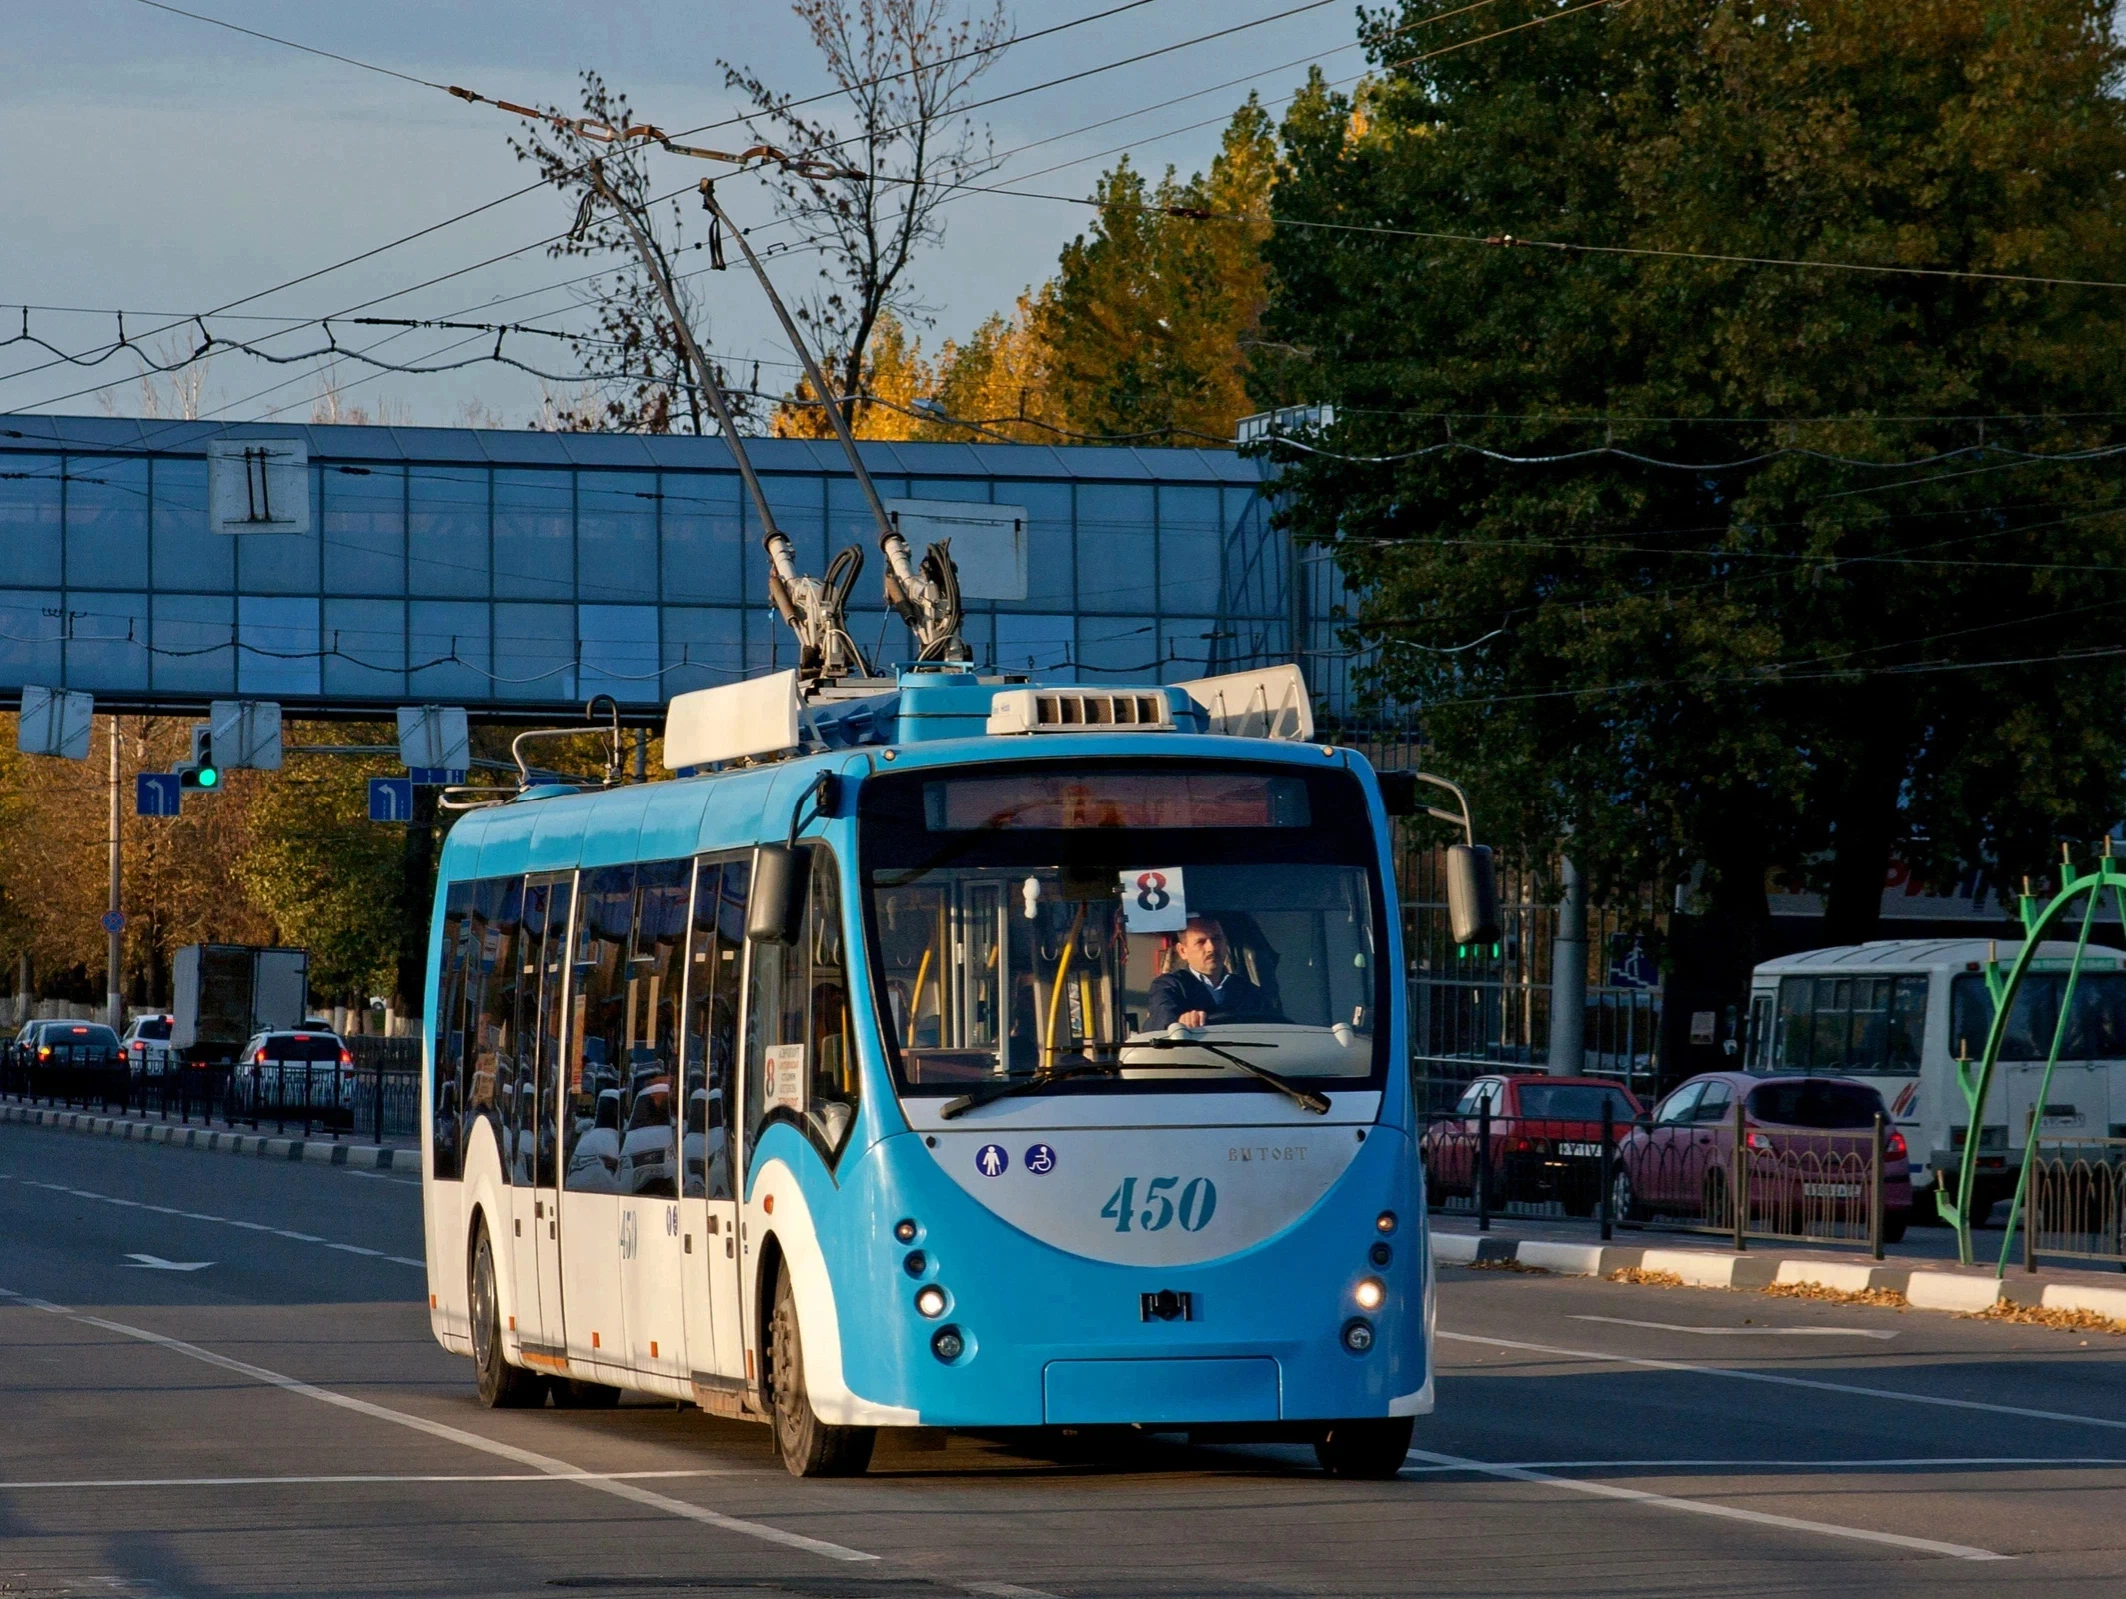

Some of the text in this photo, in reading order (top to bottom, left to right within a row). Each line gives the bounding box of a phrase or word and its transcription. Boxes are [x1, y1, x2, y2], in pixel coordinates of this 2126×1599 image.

[1137, 872, 1170, 911] 8
[766, 1058, 775, 1097] 8
[1101, 1176, 1217, 1232] 450
[620, 1210, 637, 1260] 450
